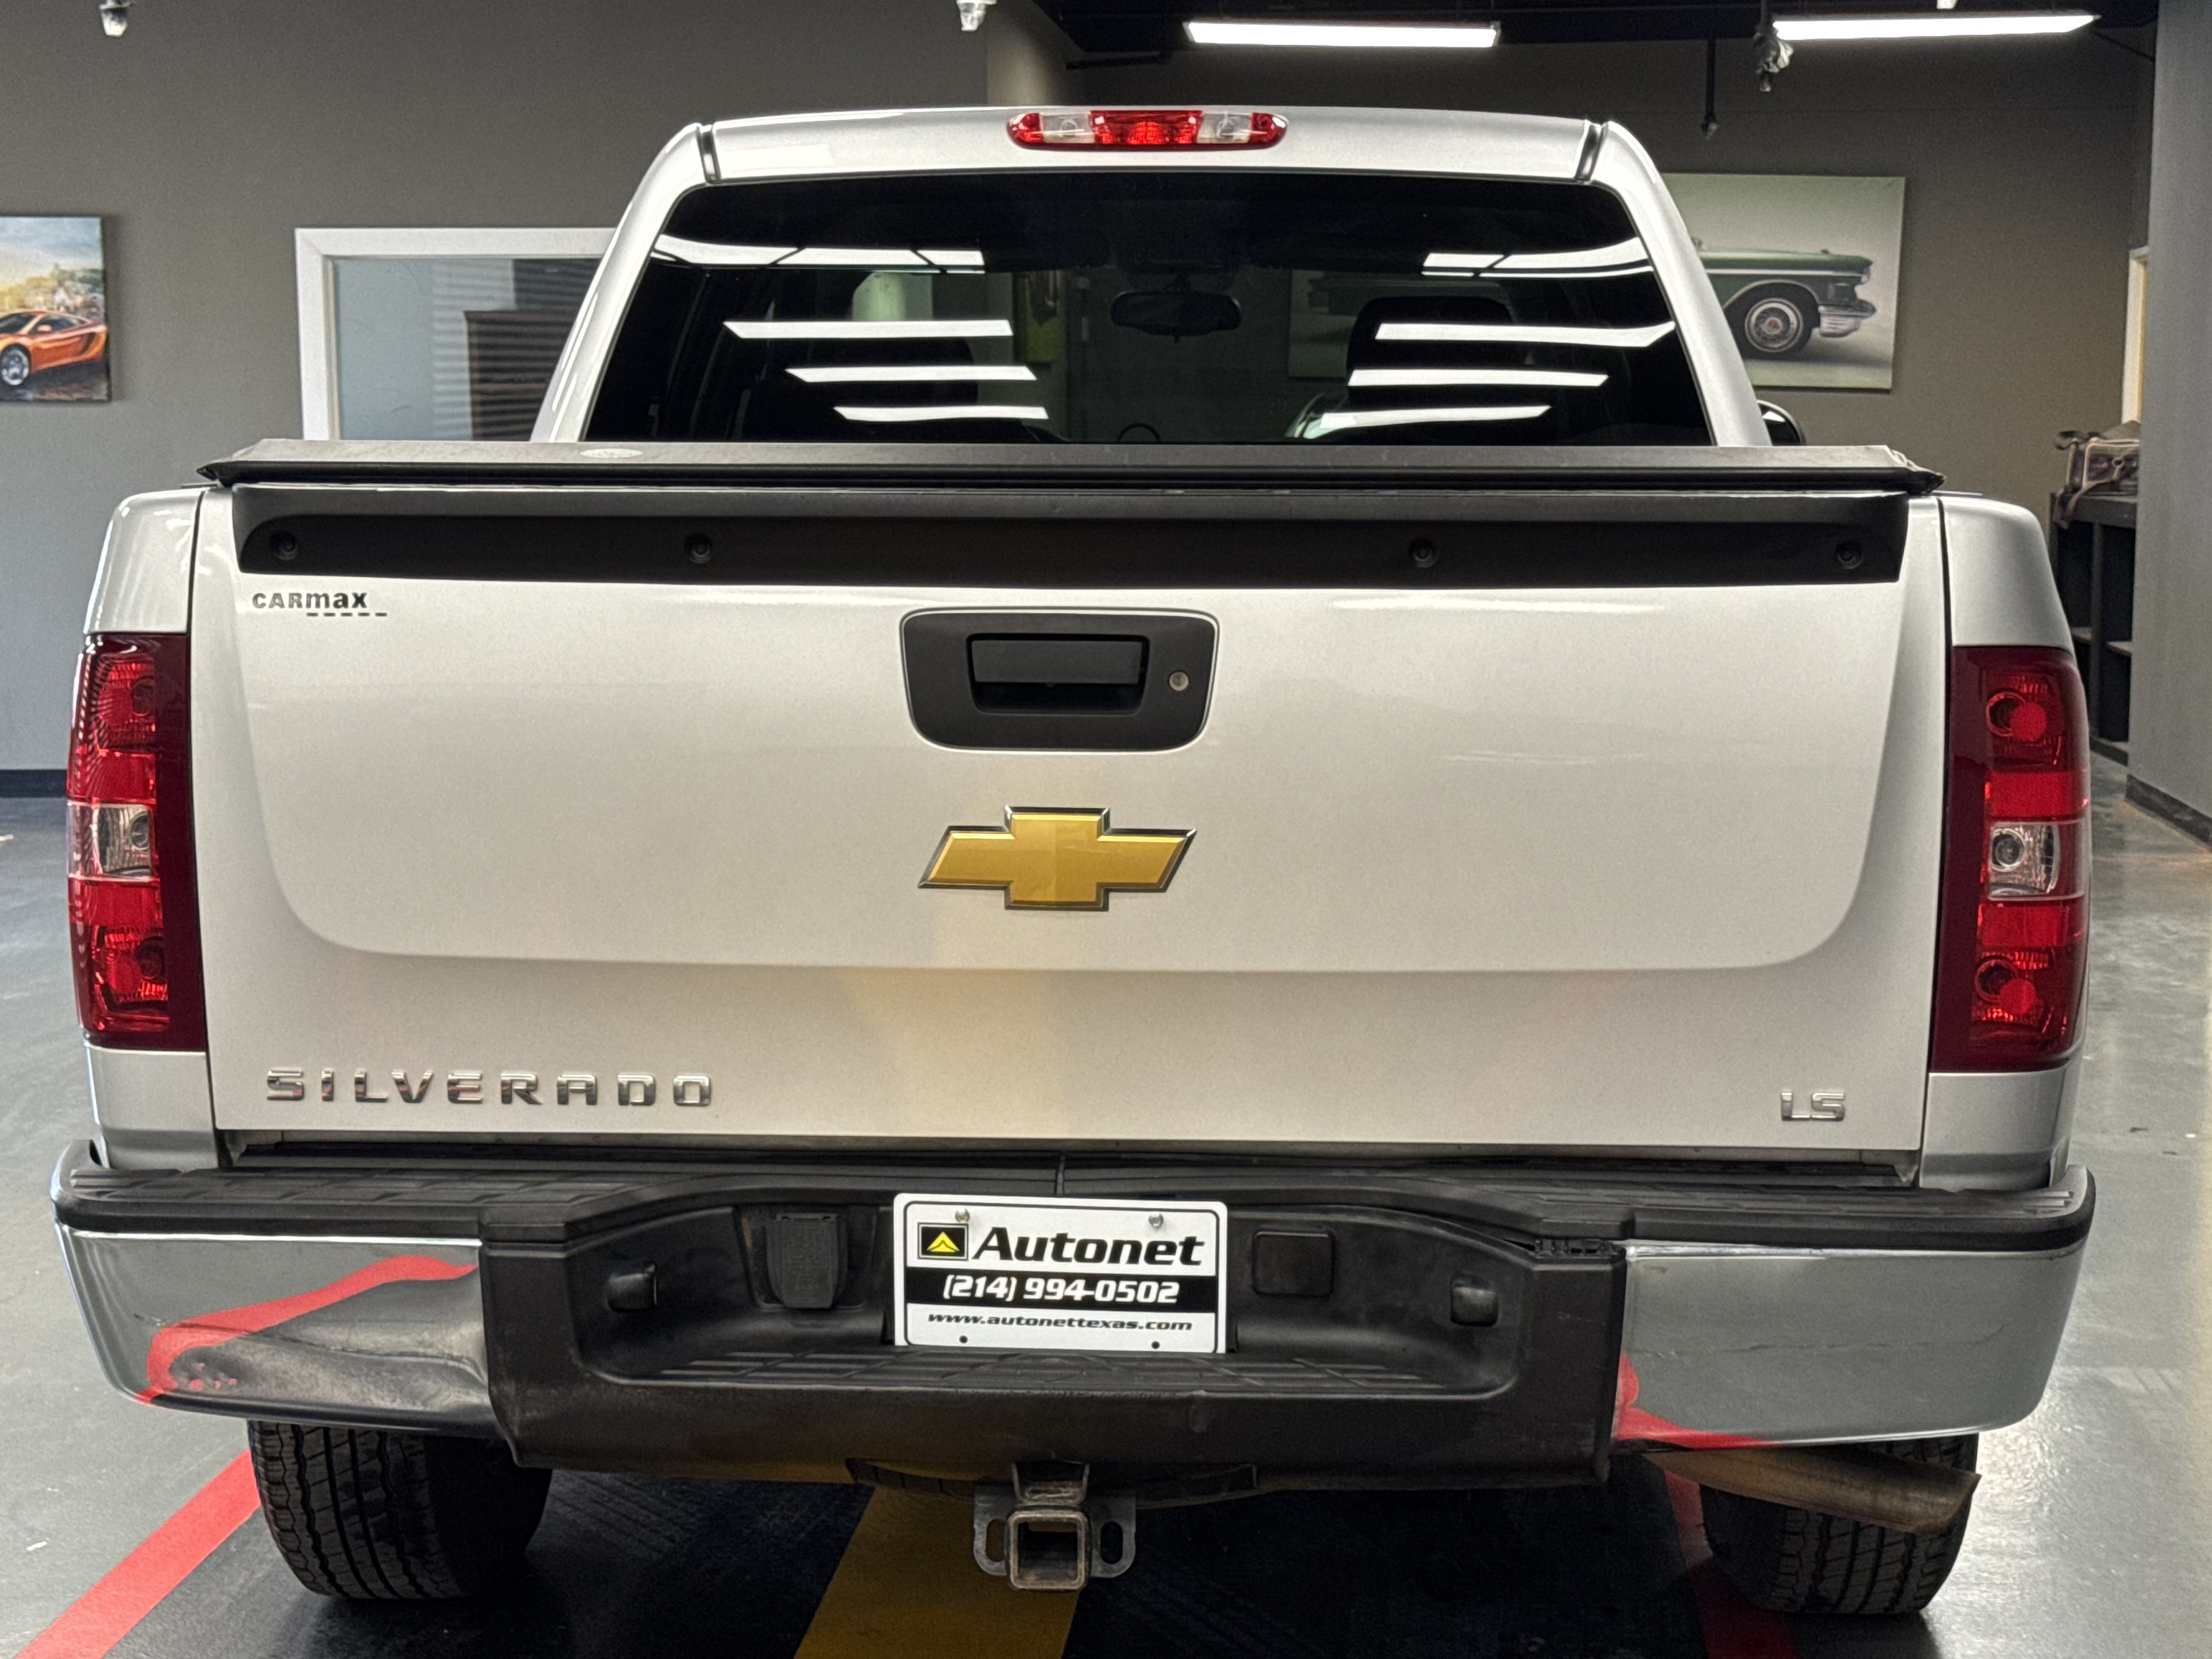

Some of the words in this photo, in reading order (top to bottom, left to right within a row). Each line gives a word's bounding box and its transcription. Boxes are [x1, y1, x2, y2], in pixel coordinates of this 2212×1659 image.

[252, 592, 368, 609] CARmax
[267, 1069, 713, 1107] SILVERADO
[1781, 1092, 1846, 1121] LS
[972, 1227, 1205, 1266] Autonet
[943, 1274, 1017, 1302] (214)
[1023, 1278, 1180, 1304] 994-0502
[928, 1313, 1193, 1331] www.autonettexas.com
